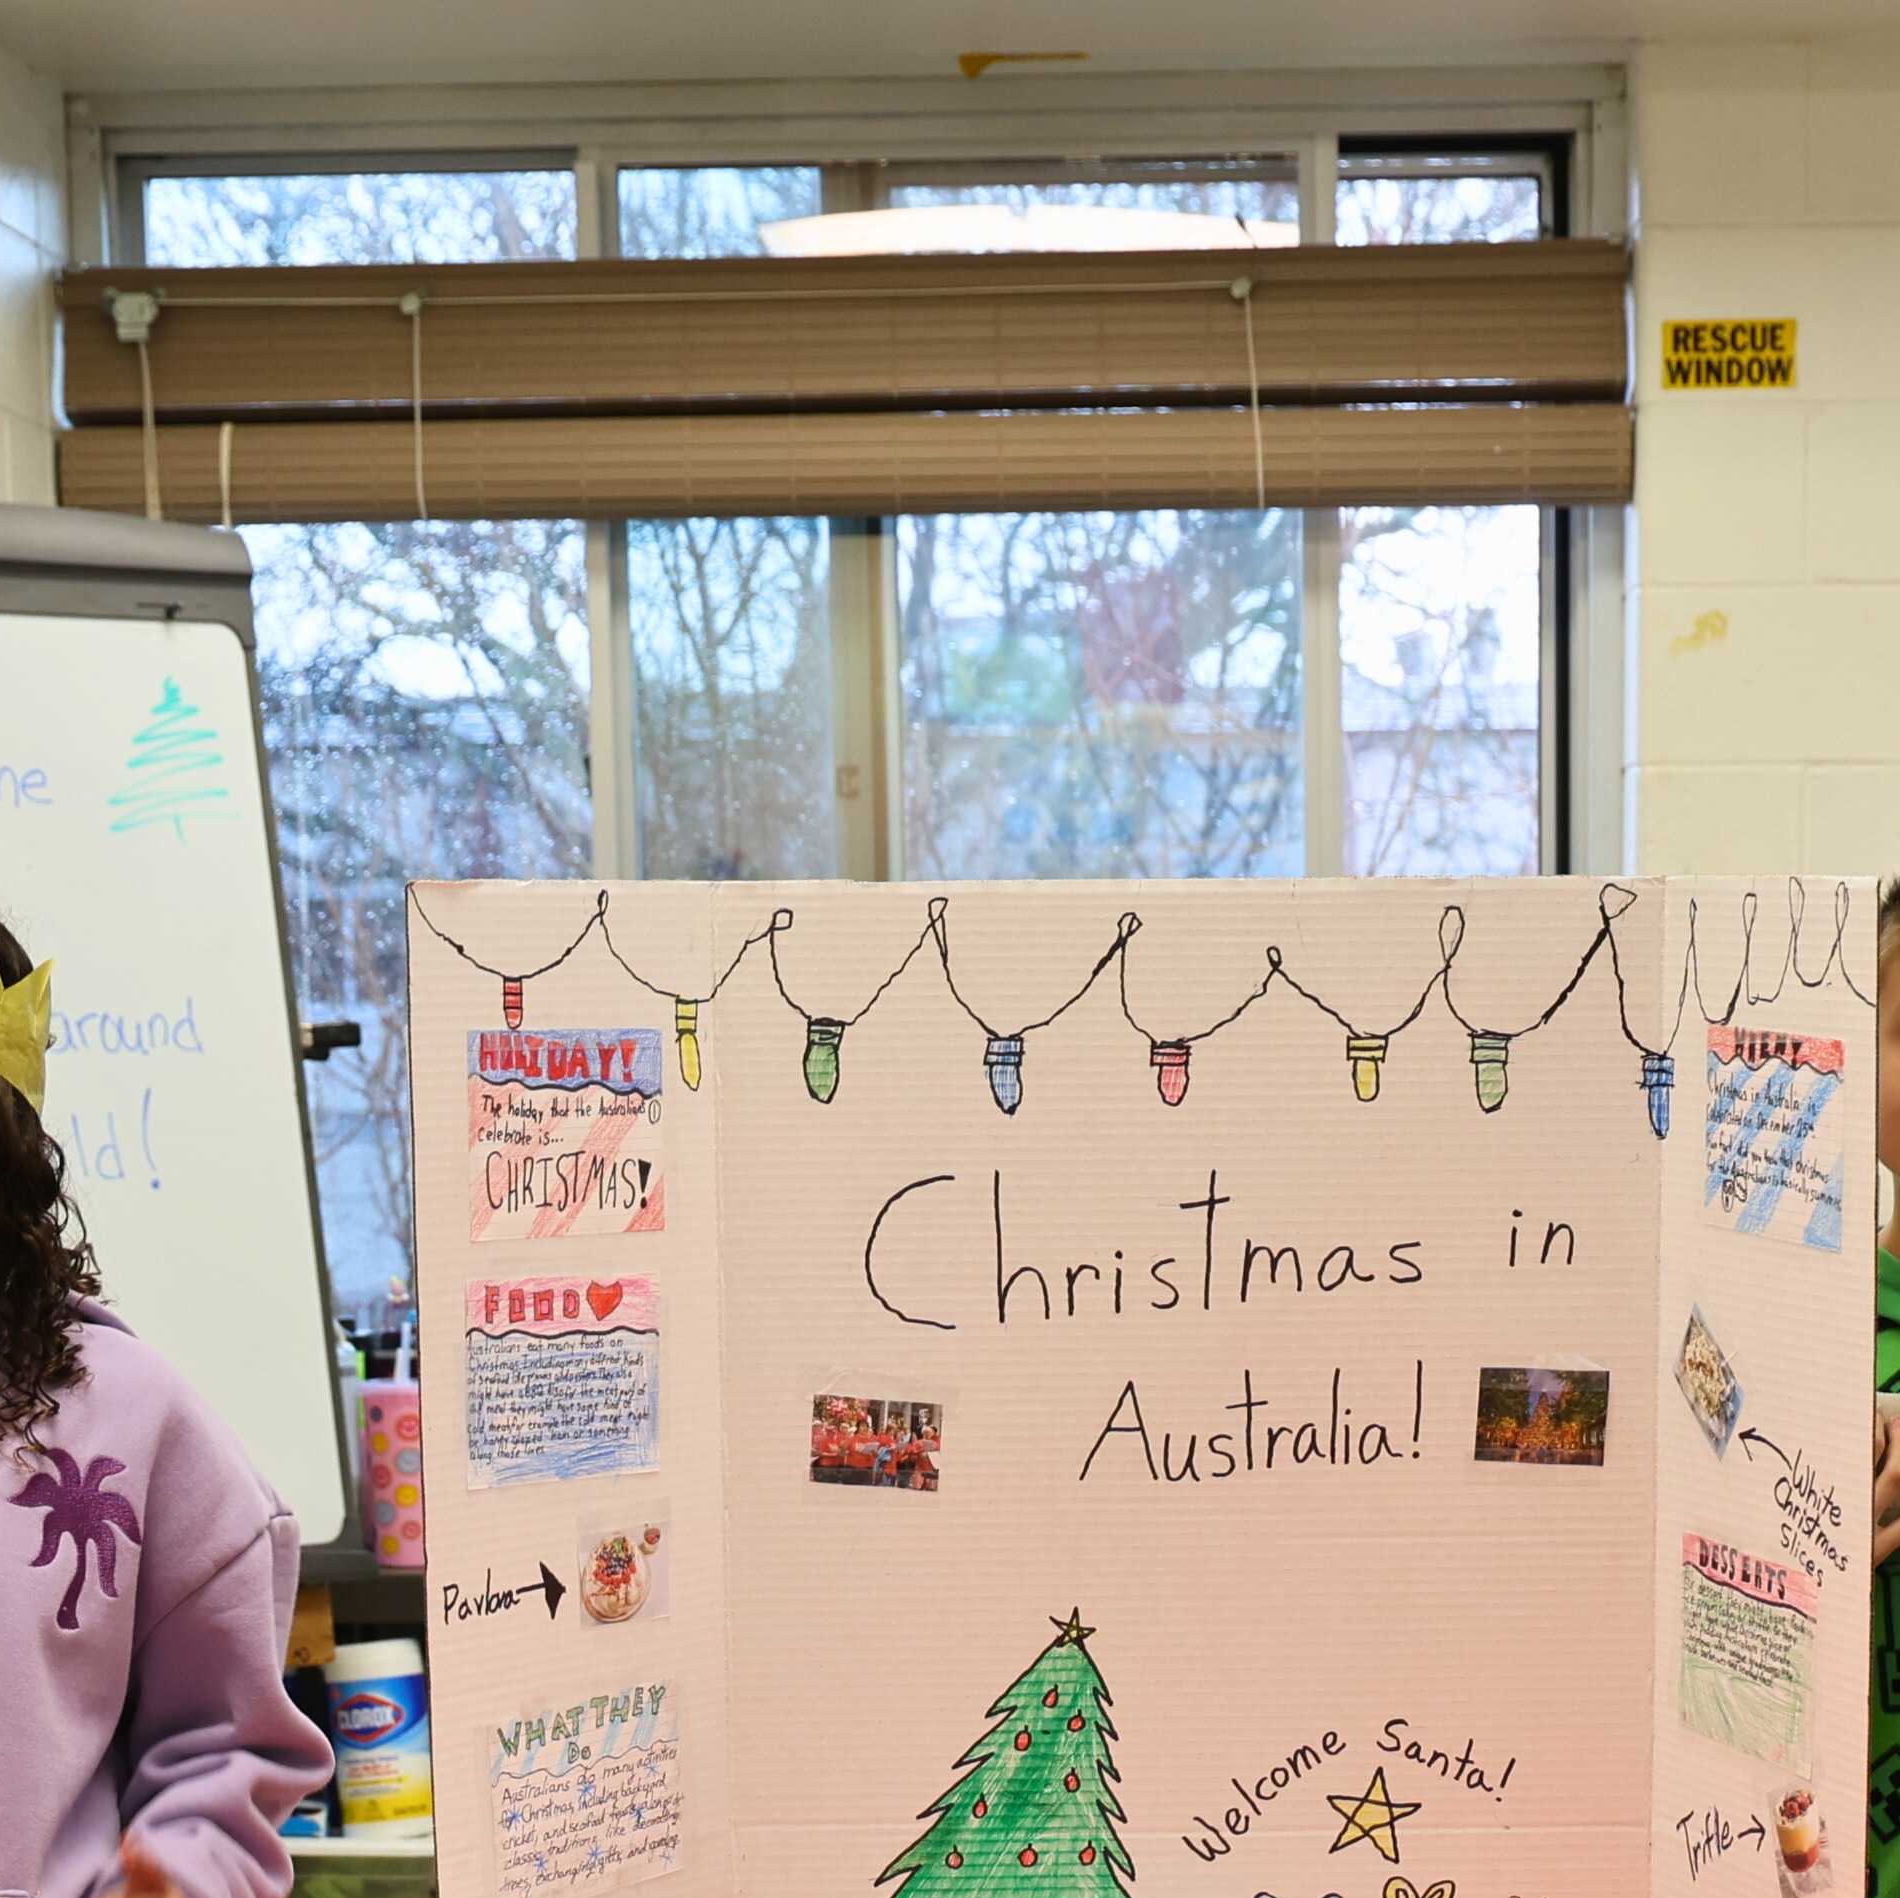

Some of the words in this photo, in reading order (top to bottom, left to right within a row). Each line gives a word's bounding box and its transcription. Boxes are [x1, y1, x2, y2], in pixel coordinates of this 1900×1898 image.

[1673, 324, 1785, 352] RESCUE
[1667, 357, 1794, 384] WINDOW
[51, 998, 204, 1055] around
[479, 1032, 637, 1082] HOLIDAY!
[482, 1094, 501, 1118] The
[508, 1094, 544, 1124] holiday
[576, 1098, 592, 1117] the
[486, 1150, 652, 1213] CHRISTMAS!
[864, 1169, 1422, 1331] Christmas
[1508, 1209, 1576, 1268] in
[485, 1285, 581, 1324] FOOD
[1080, 1359, 1422, 1482] Australia!
[1792, 1448, 1842, 1527] White
[1774, 1476, 1850, 1572] Christmas
[1781, 1523, 1824, 1587] Slices
[1699, 1536, 1788, 1600] DESSERTS
[497, 1706, 585, 1758] WHAT
[589, 1683, 666, 1729] THEY
[1182, 1730, 1347, 1862] Welcome
[1376, 1718, 1516, 1804] Santa!
[1676, 1804, 1734, 1882] Trifle
